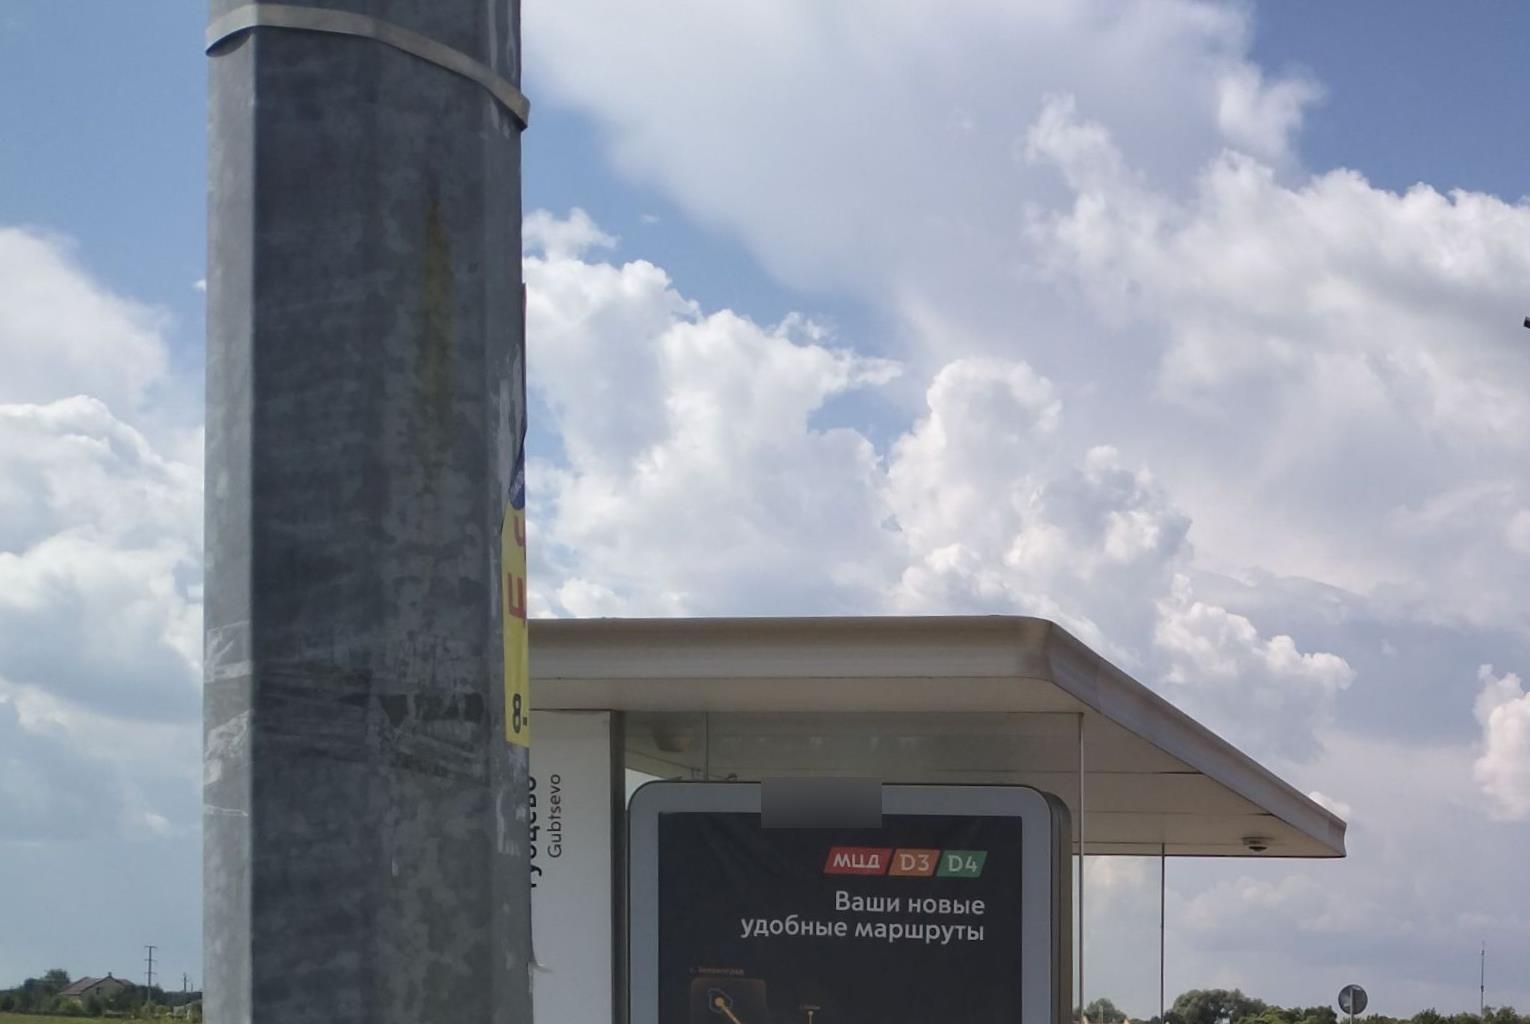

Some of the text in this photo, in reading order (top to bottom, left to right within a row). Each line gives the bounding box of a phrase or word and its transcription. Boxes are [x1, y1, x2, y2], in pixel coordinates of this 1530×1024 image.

[546, 773, 562, 858] Gubtsevo
[832, 853, 978, 873] МЦД D3 D4
[835, 890, 985, 915] Ваши новые
[740, 913, 984, 945] удобные маршруты
